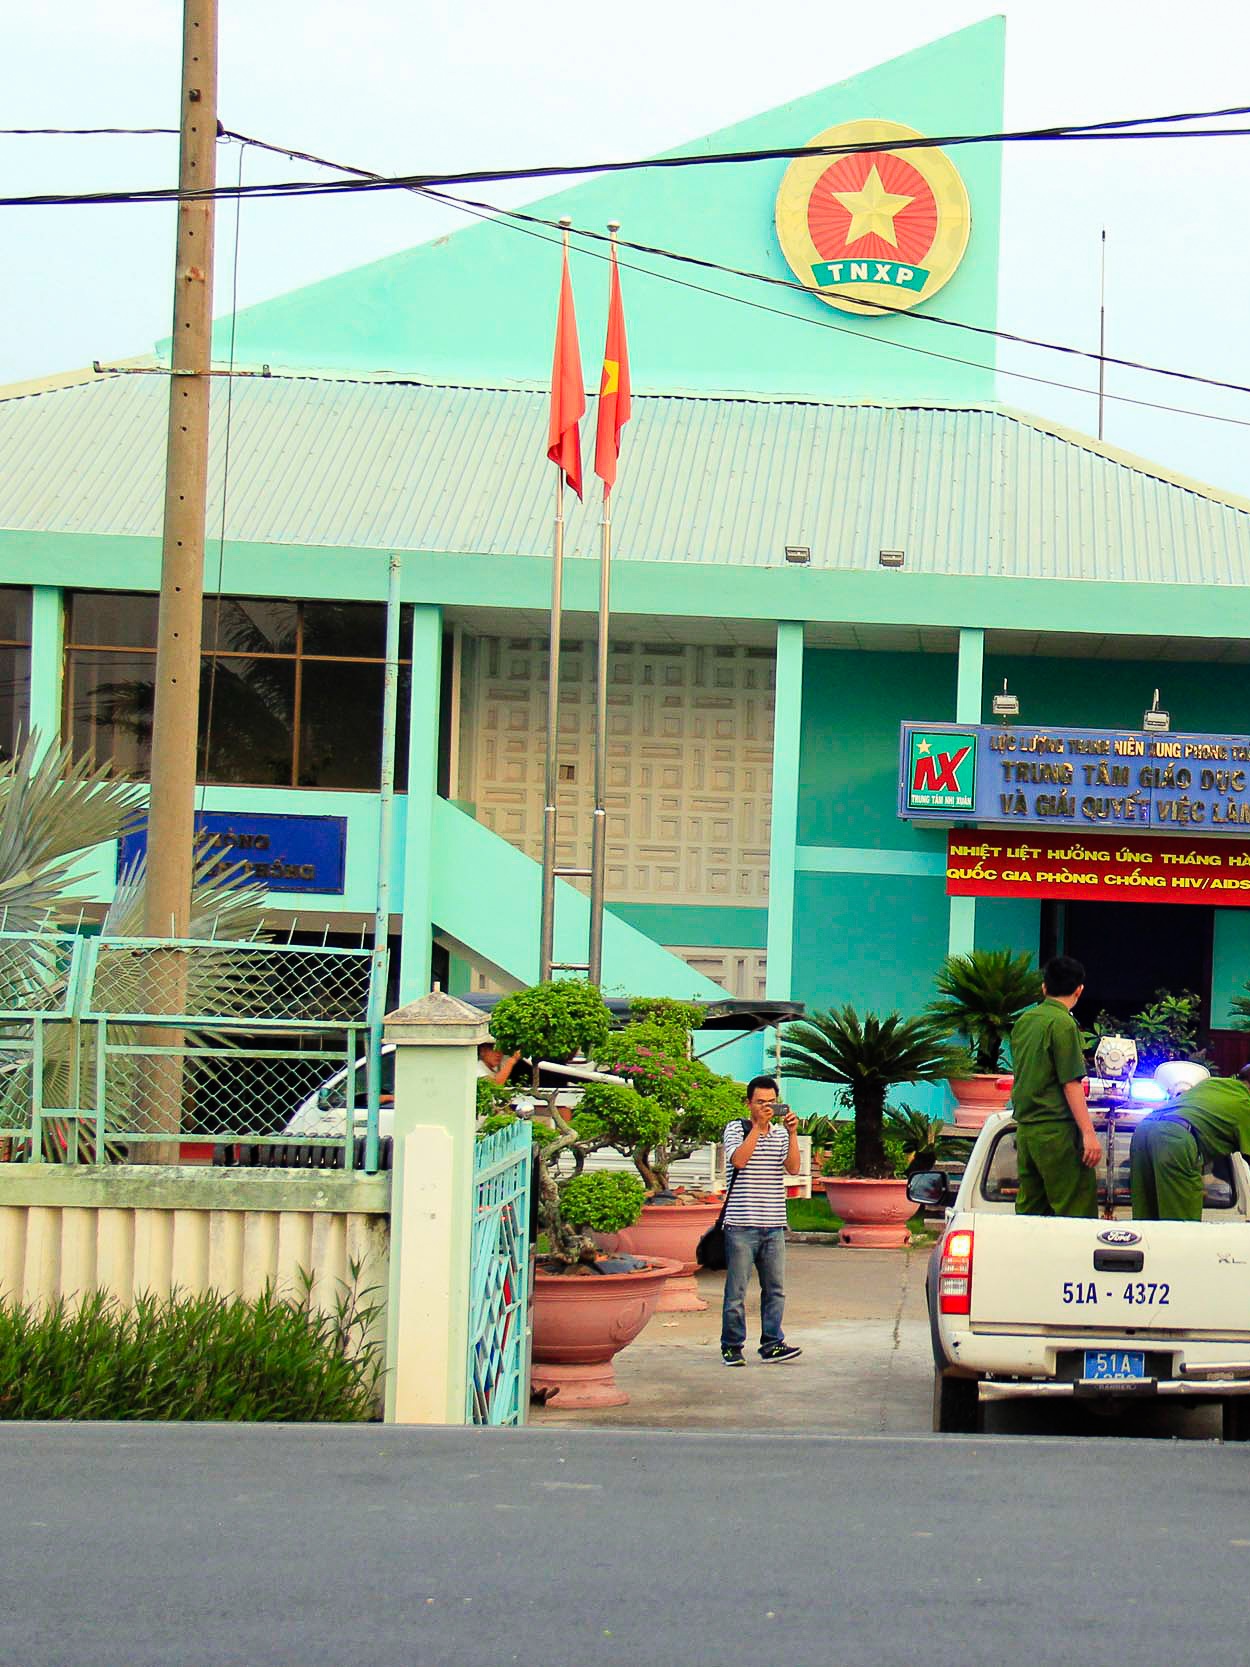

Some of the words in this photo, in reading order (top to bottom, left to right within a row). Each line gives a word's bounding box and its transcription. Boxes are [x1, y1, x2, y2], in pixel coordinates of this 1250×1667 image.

[827, 262, 915, 285] TNXP
[1114, 736, 1144, 756] NIÊN
[1001, 760, 1074, 785] TRUNG
[1083, 759, 1130, 787] TÂM
[1138, 762, 1192, 789] GIÁO
[1200, 767, 1246, 795] DỤC
[1000, 787, 1028, 815] VÀ
[1035, 786, 1076, 817] GIẢI
[1081, 788, 1150, 821] QUYẾT
[1157, 795, 1206, 826] VIỆC
[950, 843, 1002, 860] NHIỆT
[1006, 844, 1042, 861] LIỆT
[1115, 846, 1153, 863] ỨNG
[1160, 850, 1222, 866] THÁNG
[946, 861, 998, 880] QUỐC
[1001, 870, 1032, 882] GIA
[1036, 867, 1099, 885] PHÒNG
[1103, 867, 1167, 887] CHỐNG
[1106, 1230, 1132, 1243] Ford
[1062, 1282, 1098, 1305] 51A
[1123, 1282, 1170, 1305] 4372
[1097, 1353, 1131, 1373] 51A
